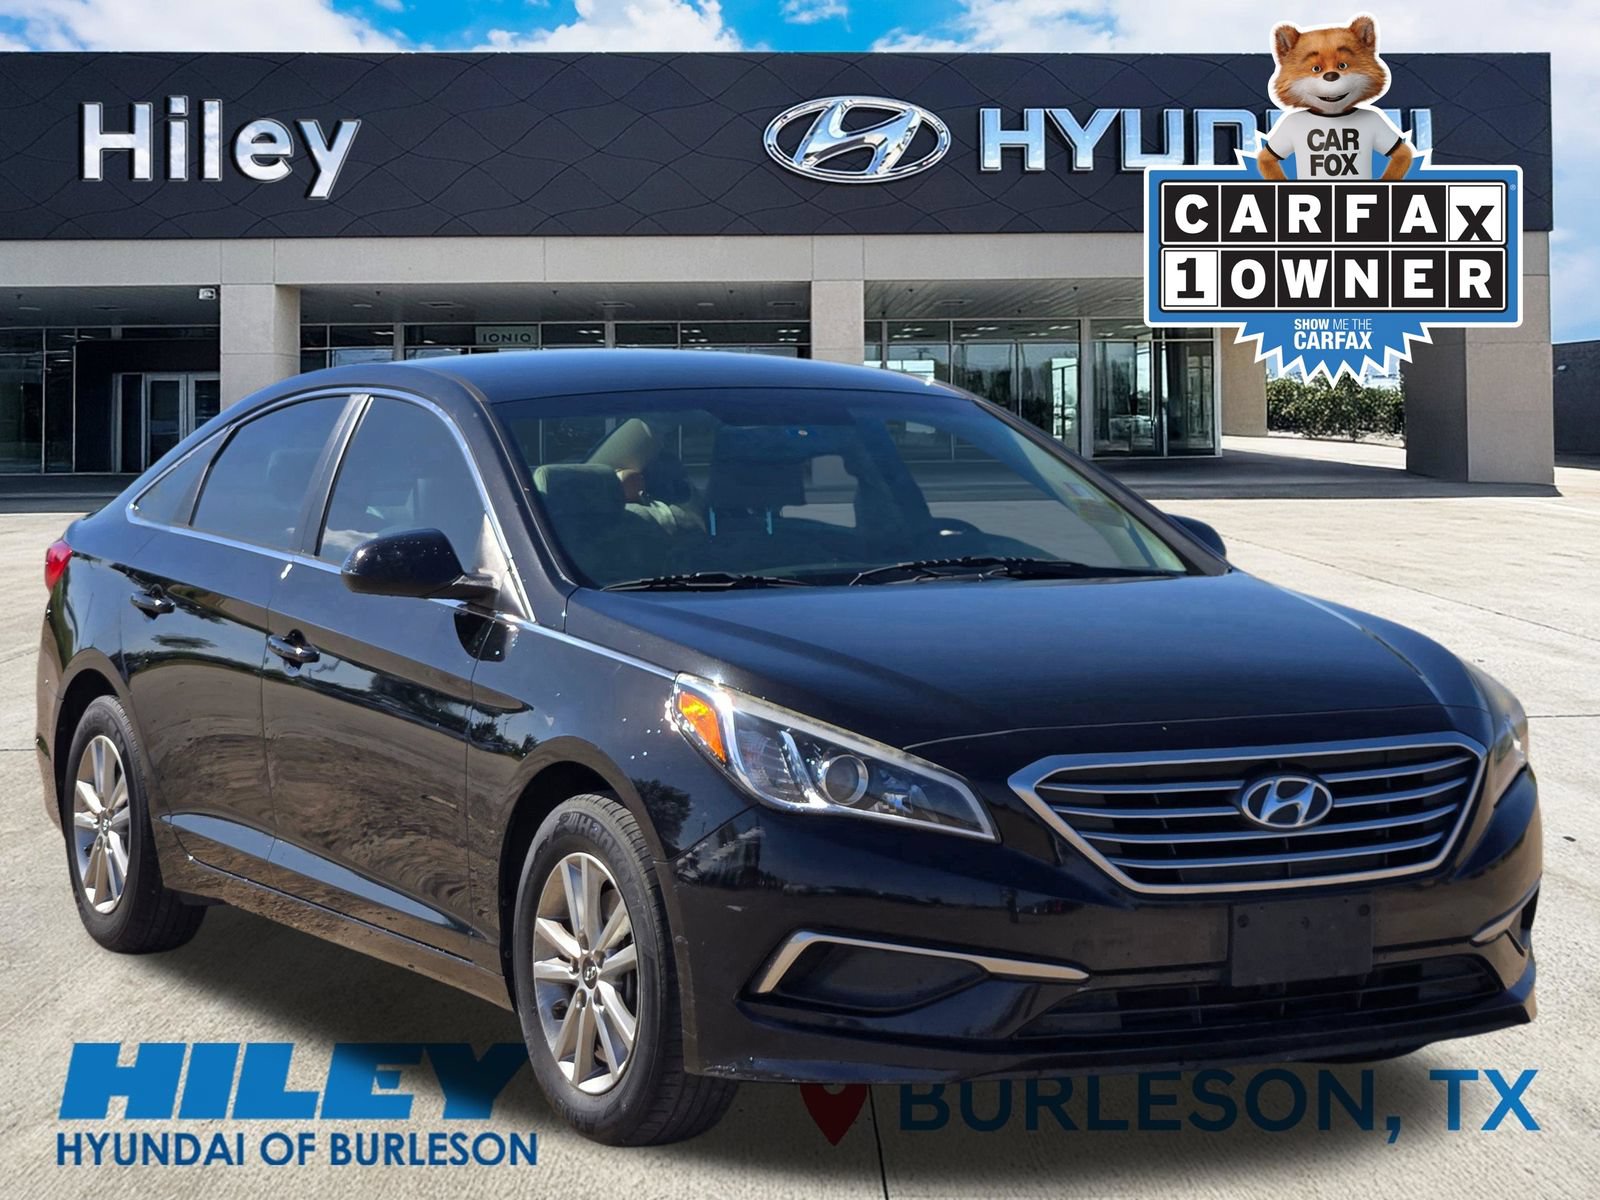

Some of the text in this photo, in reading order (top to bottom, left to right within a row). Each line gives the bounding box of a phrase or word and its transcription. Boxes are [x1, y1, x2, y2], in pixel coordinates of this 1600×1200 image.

[80, 95, 361, 199] Hiley
[979, 107, 1432, 171] HYUNI
[482, 333, 532, 343] IONIQ
